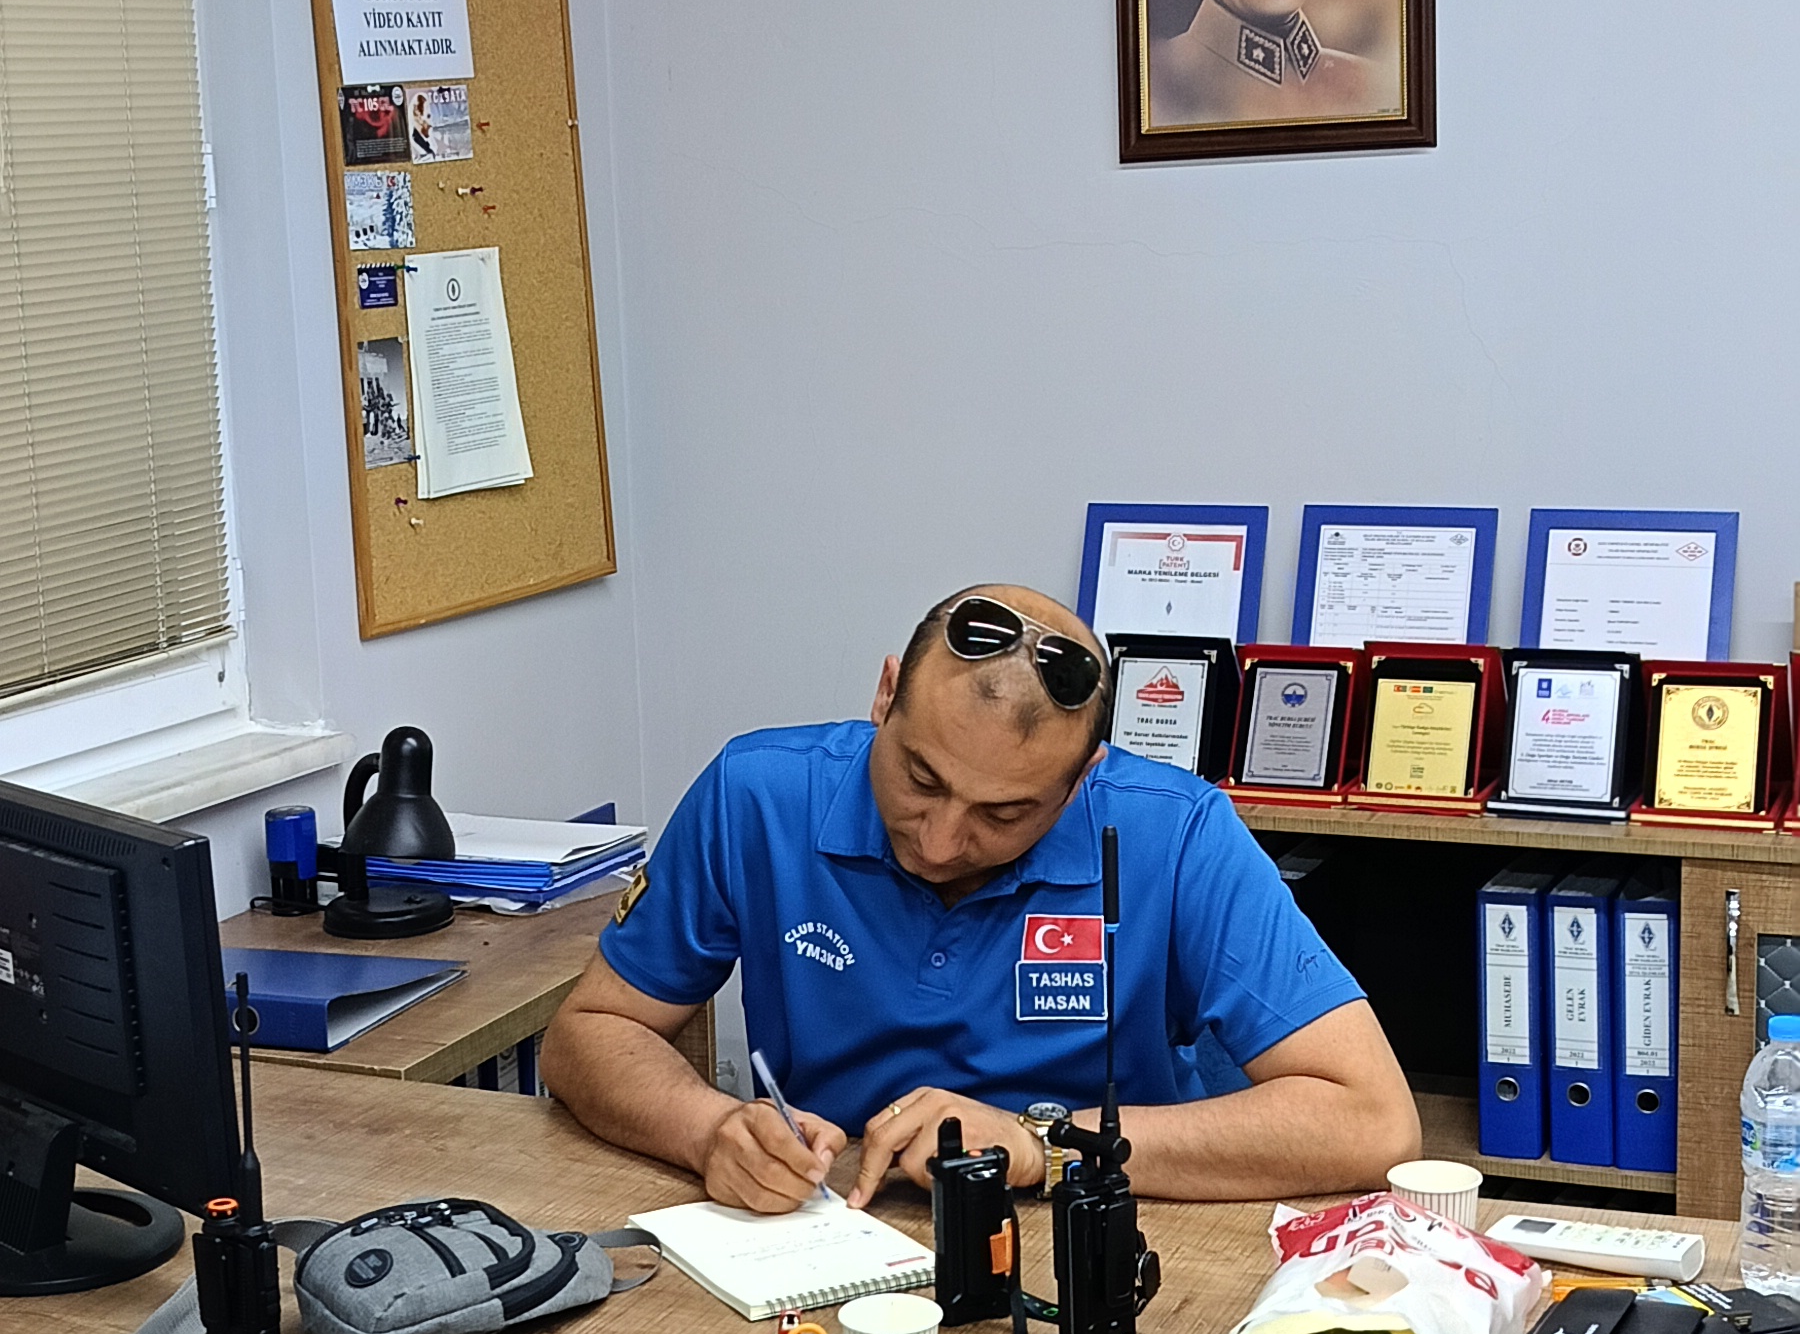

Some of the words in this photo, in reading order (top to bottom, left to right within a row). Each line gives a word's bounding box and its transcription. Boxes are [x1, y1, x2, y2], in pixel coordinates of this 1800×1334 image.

[363, 9, 403, 29] VİDEO
[406, 11, 443, 28] KAYIT
[358, 38, 456, 57] ALINMAKTADIR.
[784, 921, 815, 944] CLUB
[815, 922, 856, 967] STATION
[795, 939, 845, 972] YM3KB
[1028, 972, 1095, 988] TA3HAS
[1642, 978, 1652, 1013] EVRAK
[1034, 995, 1091, 1011] HASAN
[1503, 975, 1512, 1028] MUHASEBE
[1566, 987, 1575, 1021] GELEN
[1578, 988, 1587, 1022] EVRAK
